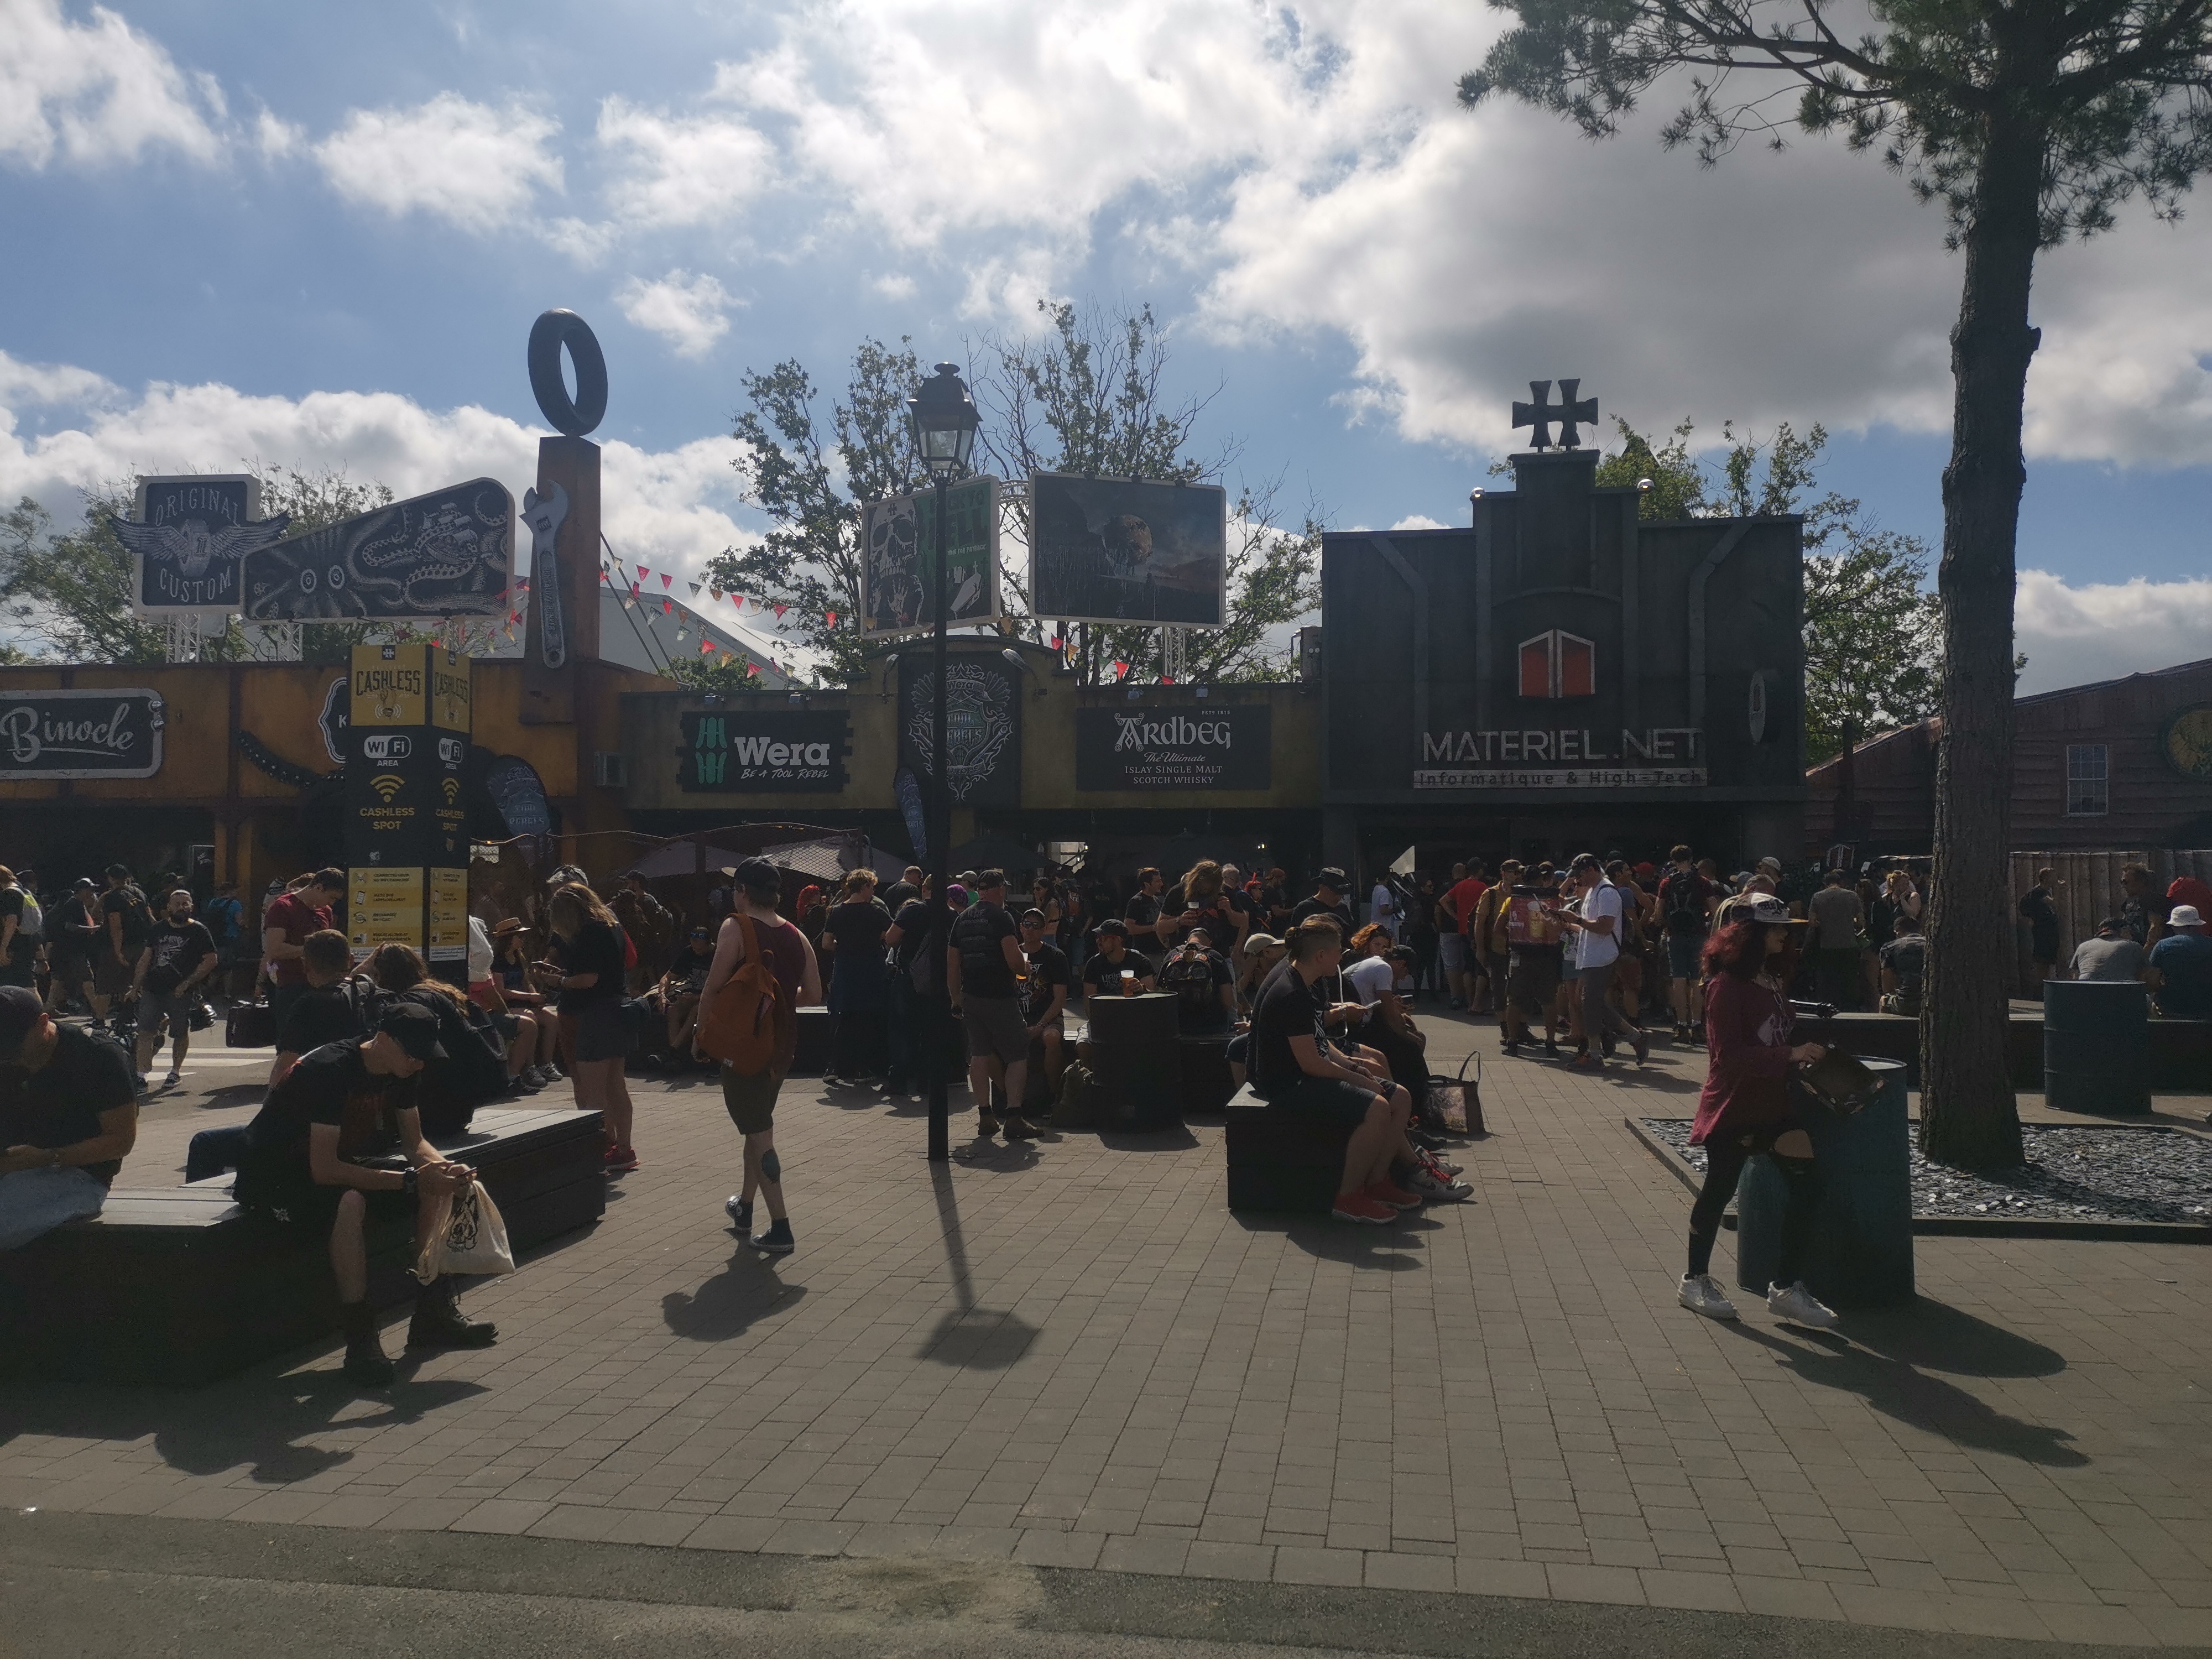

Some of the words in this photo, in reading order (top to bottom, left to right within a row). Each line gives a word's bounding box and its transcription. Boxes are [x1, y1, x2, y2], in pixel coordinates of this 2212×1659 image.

[155, 487, 241, 527] ORIGINAL
[160, 566, 232, 603] CUSTOM
[356, 670, 420, 696] CASHLESS
[0, 703, 134, 763] Binocle
[947, 728, 983, 747] EBELS
[734, 737, 830, 766] Wera
[1423, 728, 1703, 762] MATERIEL.NET
[1144, 752, 1161, 763] The
[1161, 752, 1207, 763] Ultimate
[740, 769, 755, 780] BE
[771, 768, 794, 779] TOOL
[797, 769, 830, 780] REBEL
[947, 765, 980, 775] UROPE
[1125, 766, 1152, 774] ISLAY
[1156, 766, 1192, 774] SINGLE
[1196, 765, 1223, 774] MALT
[1420, 771, 1554, 786] Informatique
[1567, 771, 1578, 784] &
[1590, 770, 1702, 786] High-Tech
[359, 807, 415, 817] CASHLESS
[373, 821, 402, 830] SPOT
